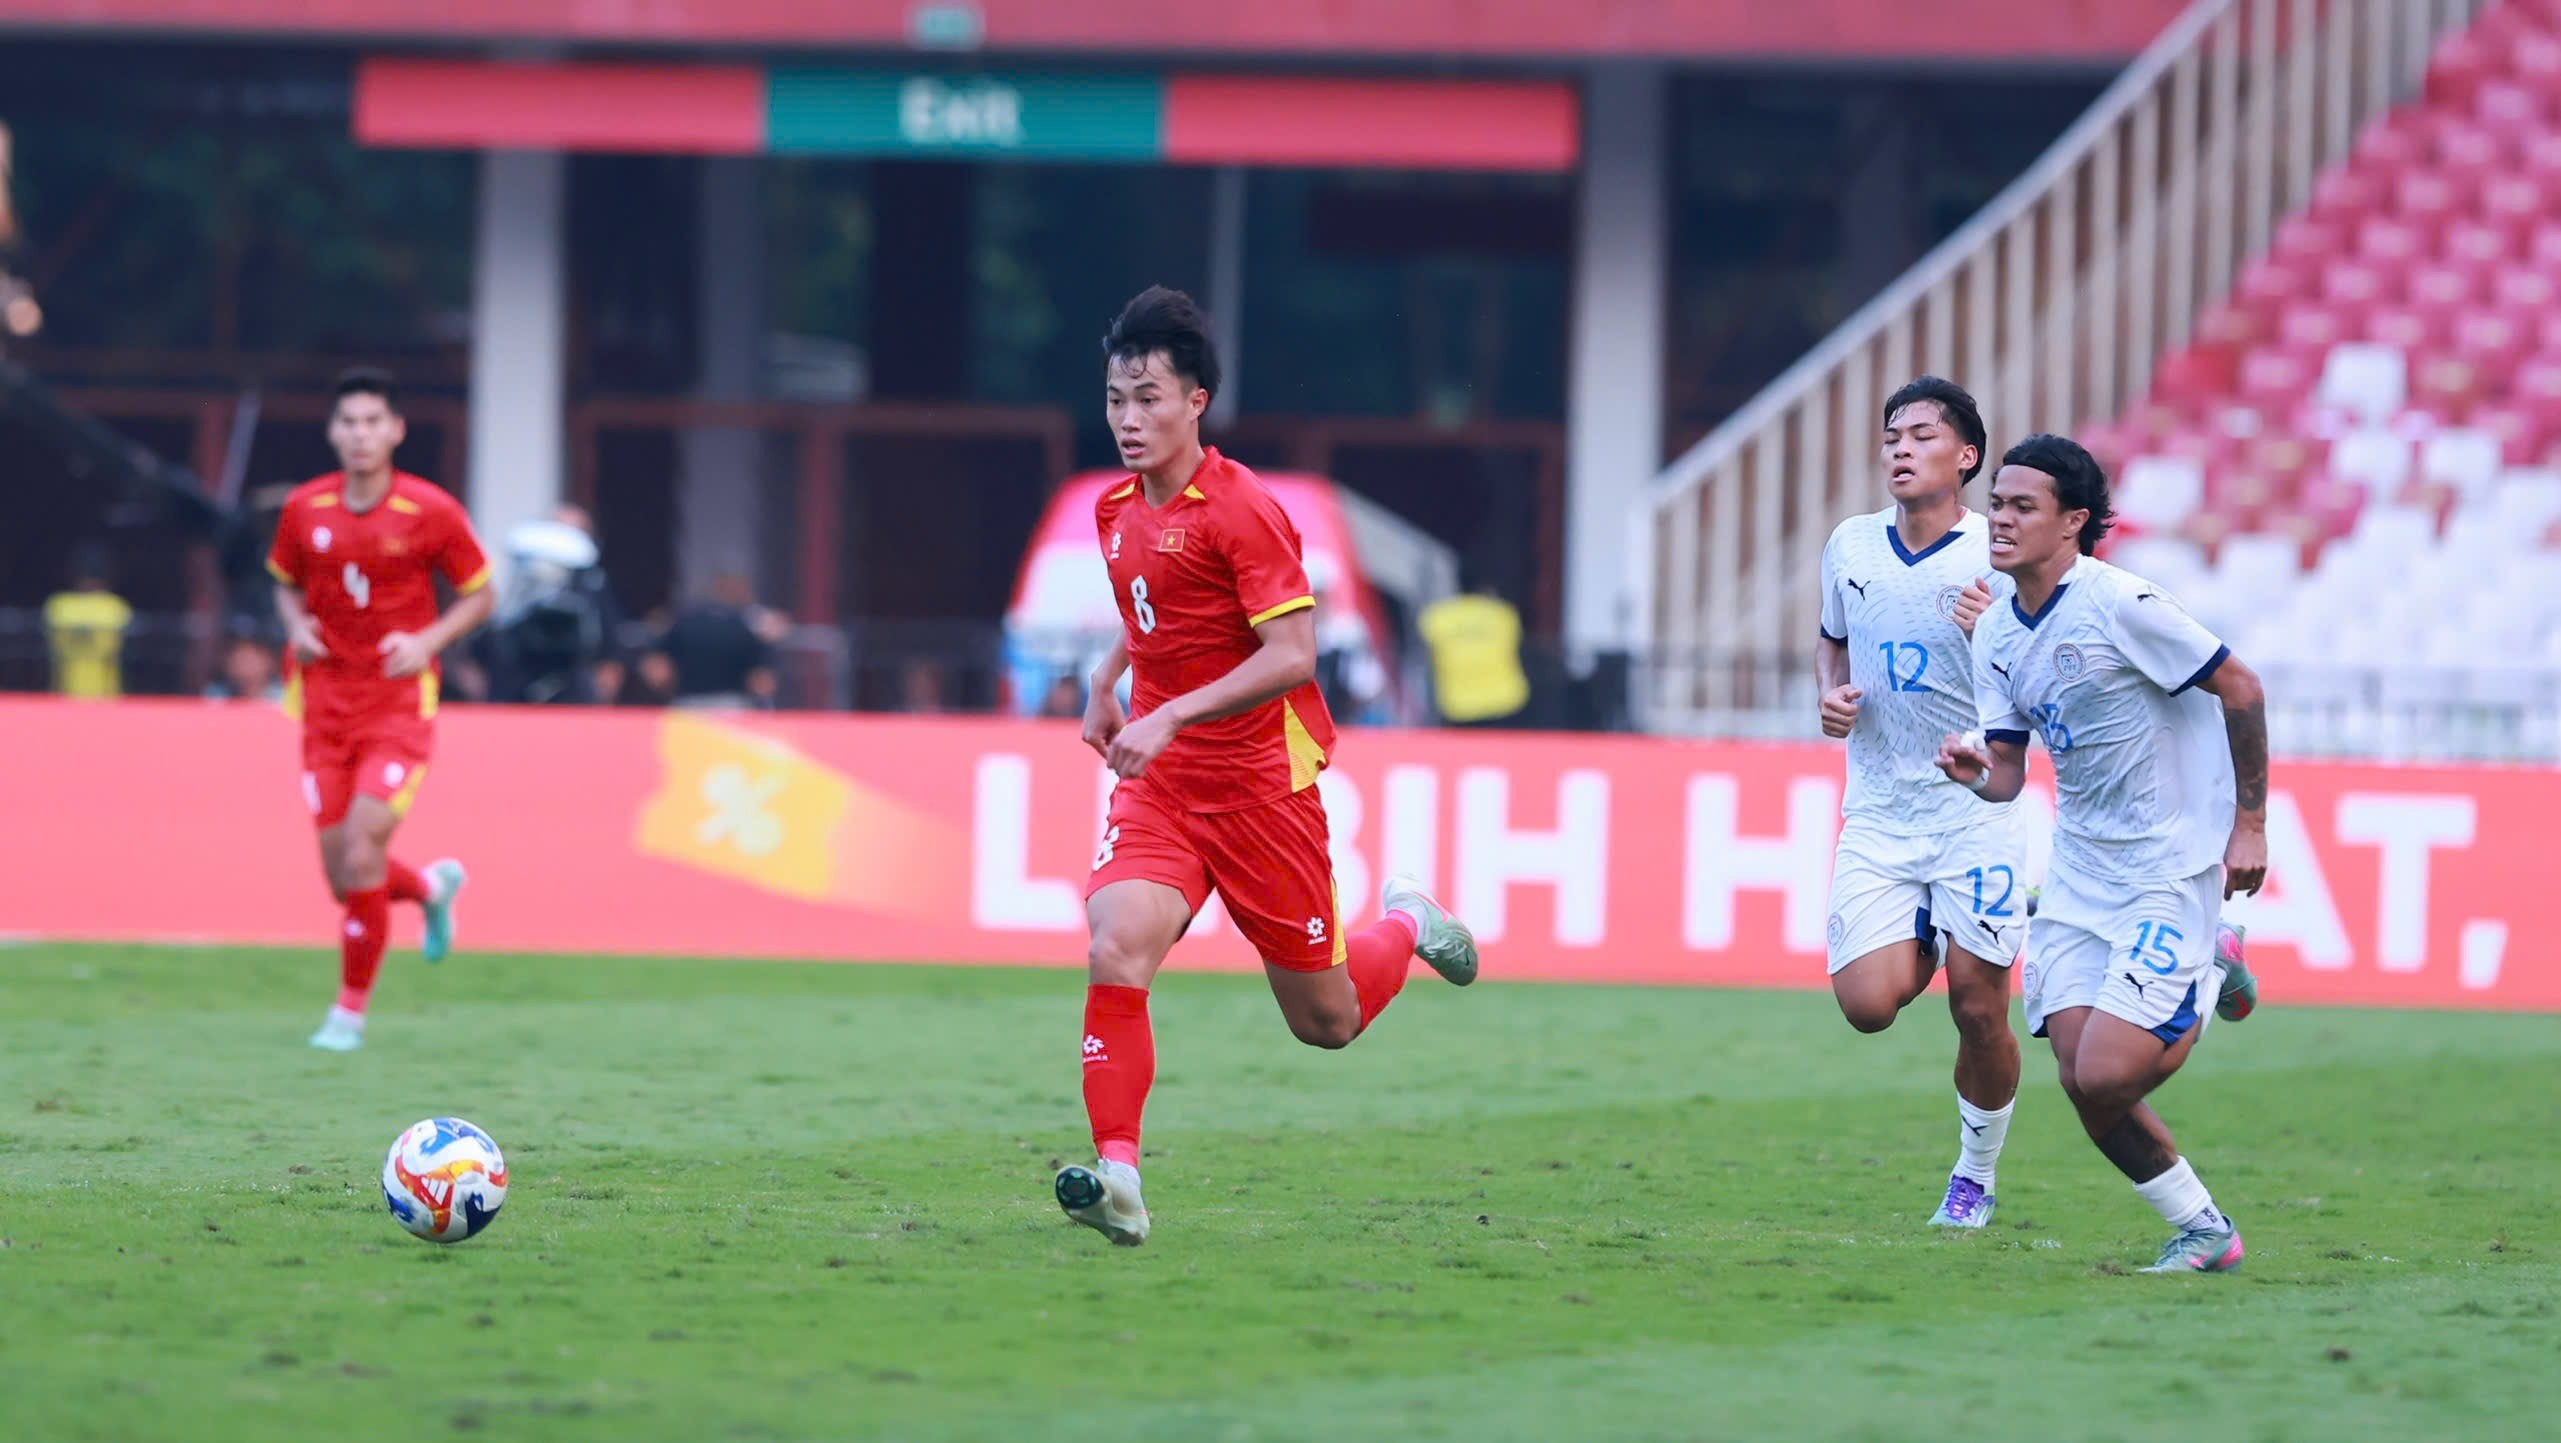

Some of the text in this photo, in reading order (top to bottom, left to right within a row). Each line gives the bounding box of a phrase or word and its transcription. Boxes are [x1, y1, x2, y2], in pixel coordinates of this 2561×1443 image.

[1130, 574, 1156, 635] 8
[1879, 640, 1933, 692] 12
[2029, 703, 2074, 753] 15
[972, 752, 2510, 990] LIH HAT,
[1091, 825, 1120, 872] 8
[1965, 864, 2014, 917] 12
[2128, 920, 2184, 976] 15
